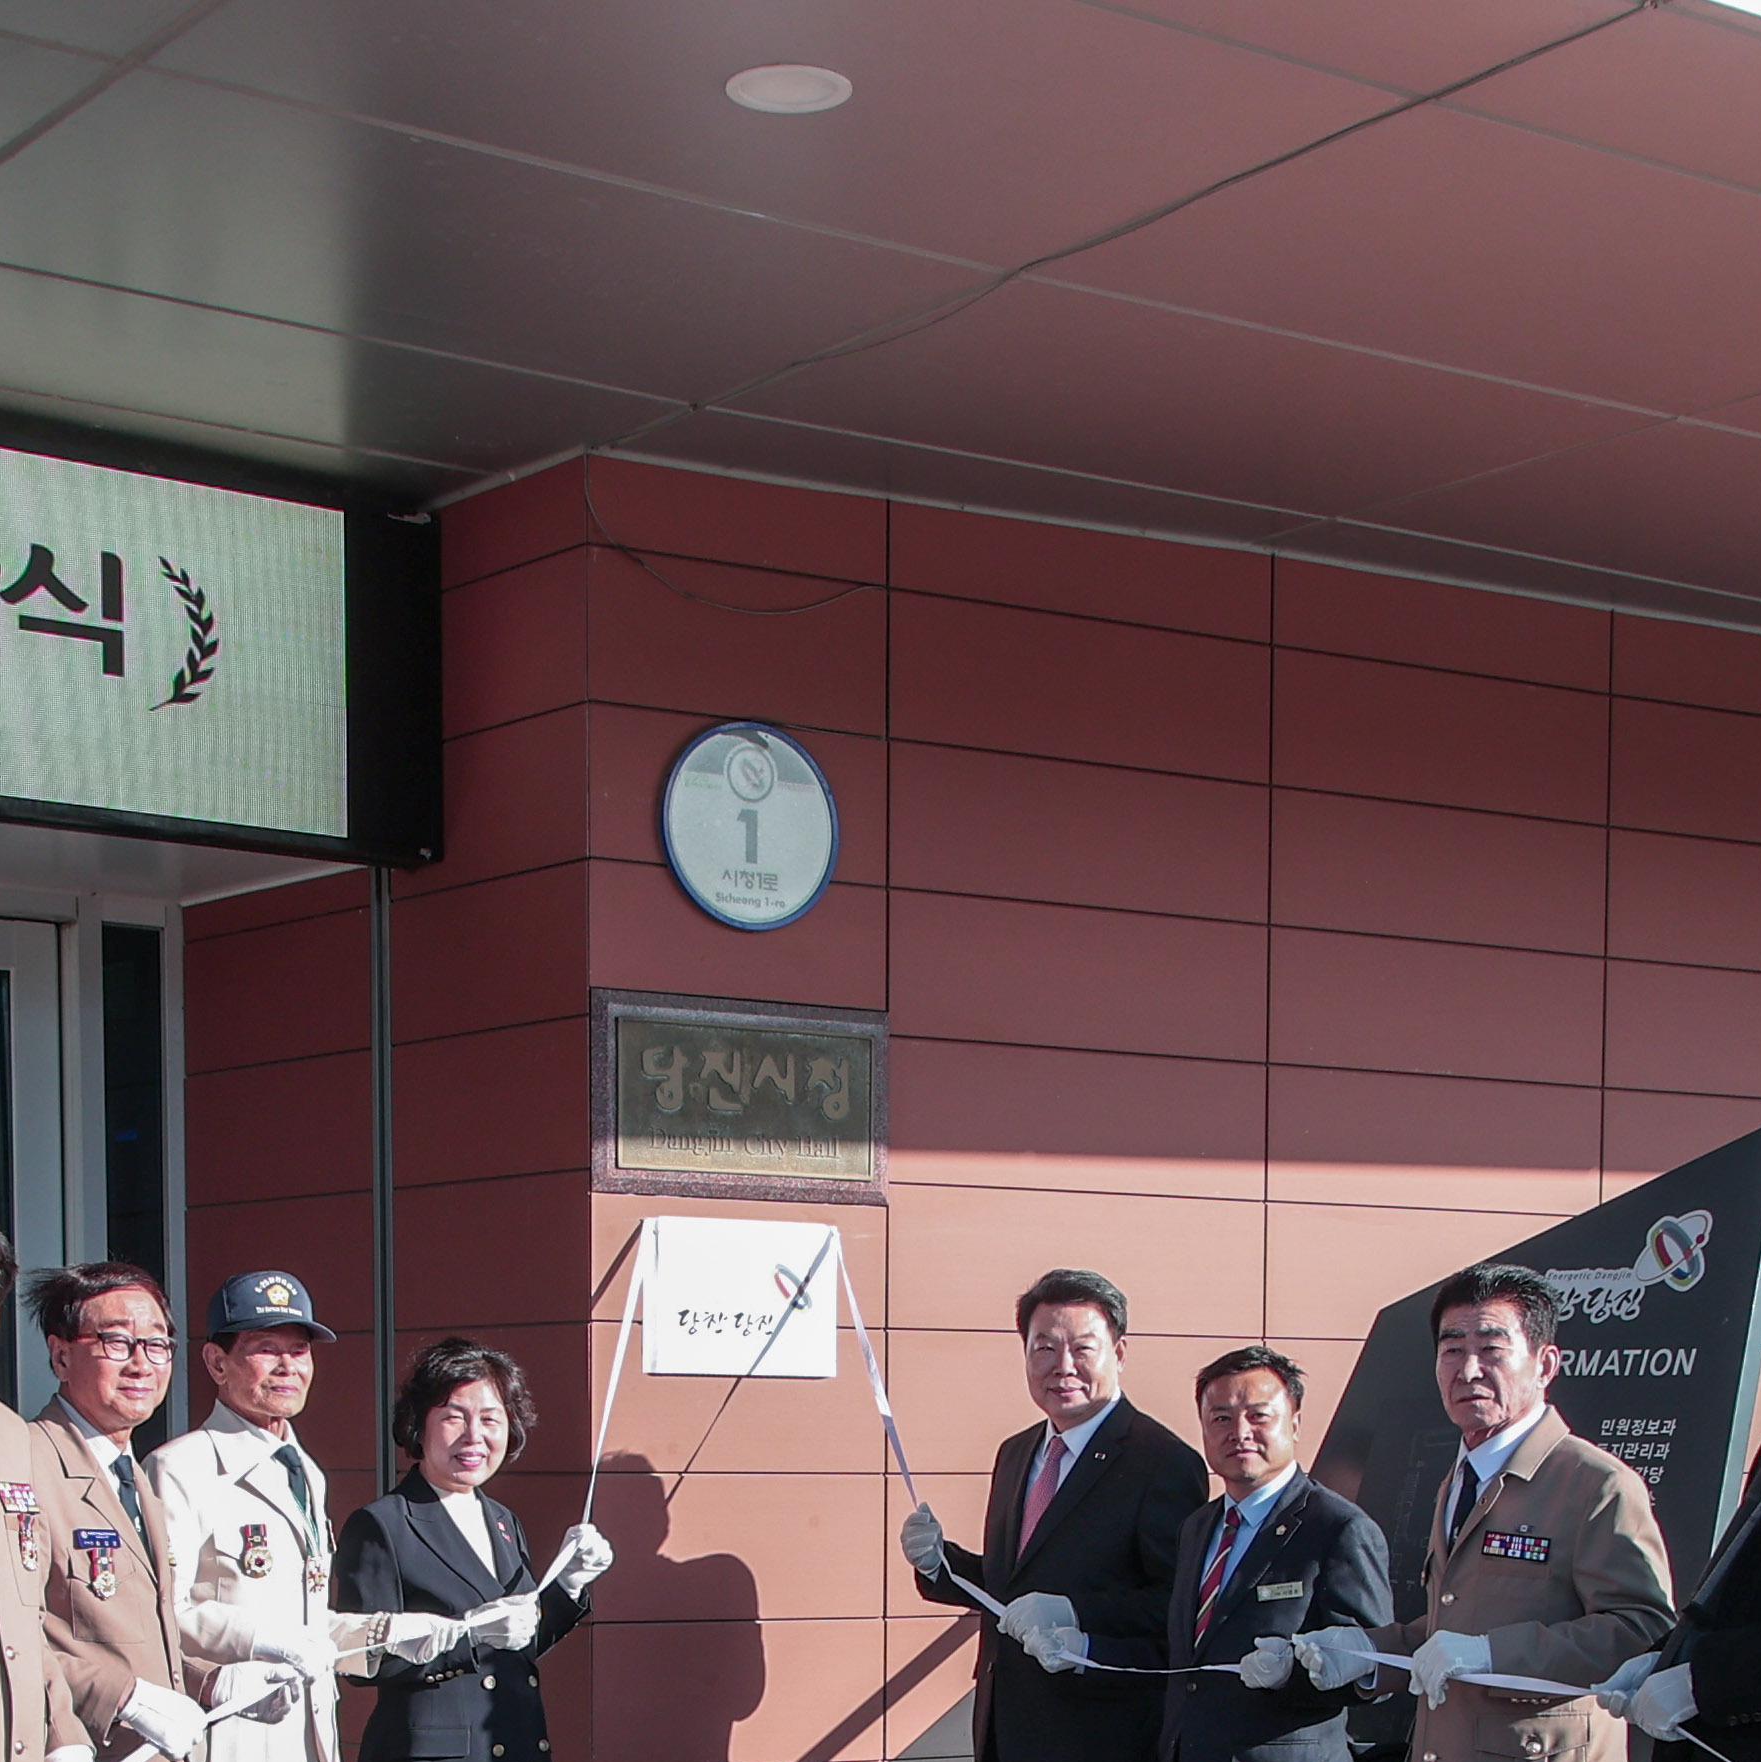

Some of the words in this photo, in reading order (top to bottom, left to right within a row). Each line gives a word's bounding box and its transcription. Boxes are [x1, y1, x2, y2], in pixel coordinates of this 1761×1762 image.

[736, 807, 759, 865] 1
[721, 870, 779, 892] 시청1로
[715, 892, 762, 909] Sicheong
[641, 1045, 851, 1123] 당진시청
[649, 1126, 734, 1156] Dangjin
[743, 1134, 788, 1160] City
[796, 1135, 840, 1160] Hall
[1594, 1271, 1633, 1282] Dangjin
[1555, 1348, 1697, 1377] RMATION
[1600, 1418, 1677, 1437] 민원정보과
